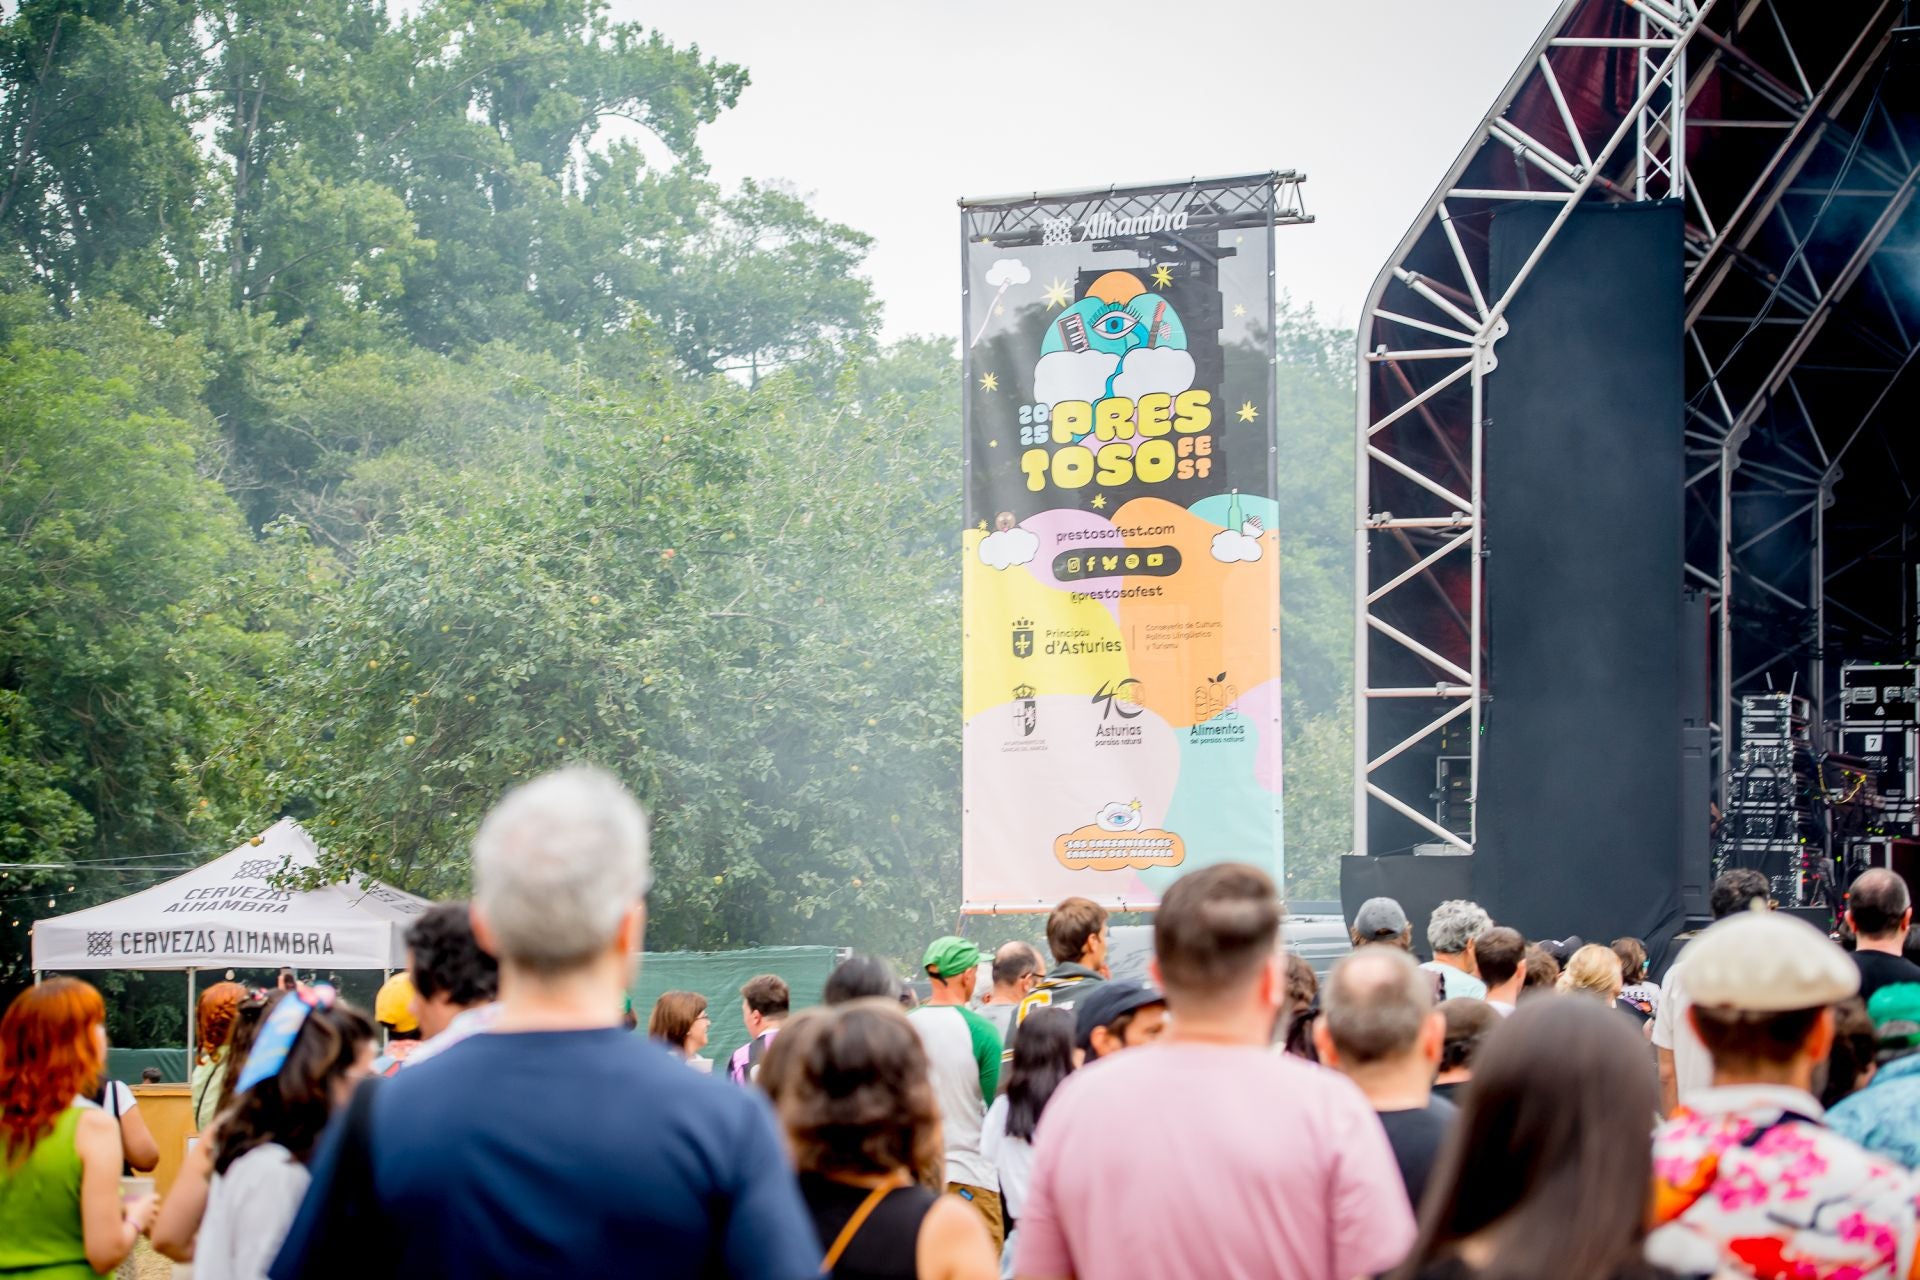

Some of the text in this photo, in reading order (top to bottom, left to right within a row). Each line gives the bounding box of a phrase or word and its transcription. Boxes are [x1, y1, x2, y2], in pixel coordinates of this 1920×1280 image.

[1078, 206, 1189, 244] Alhambra
[1019, 403, 1049, 424] 20
[1051, 389, 1212, 443] PRES
[1020, 425, 1049, 445] 25
[1177, 435, 1212, 457] FE
[1021, 439, 1176, 491] TOSO
[1177, 457, 1212, 480] ST
[1056, 524, 1175, 545] prestosofest.com
[1070, 585, 1163, 604] @prestosofest
[1045, 637, 1121, 655] d'Asturies
[1096, 723, 1142, 737] Asturias
[1190, 723, 1245, 737] Alimentos
[184, 885, 295, 901] CERVEZAS
[163, 900, 289, 913] ALHAMBRA
[120, 930, 335, 955] CERVEZAS ALHAMBRA
